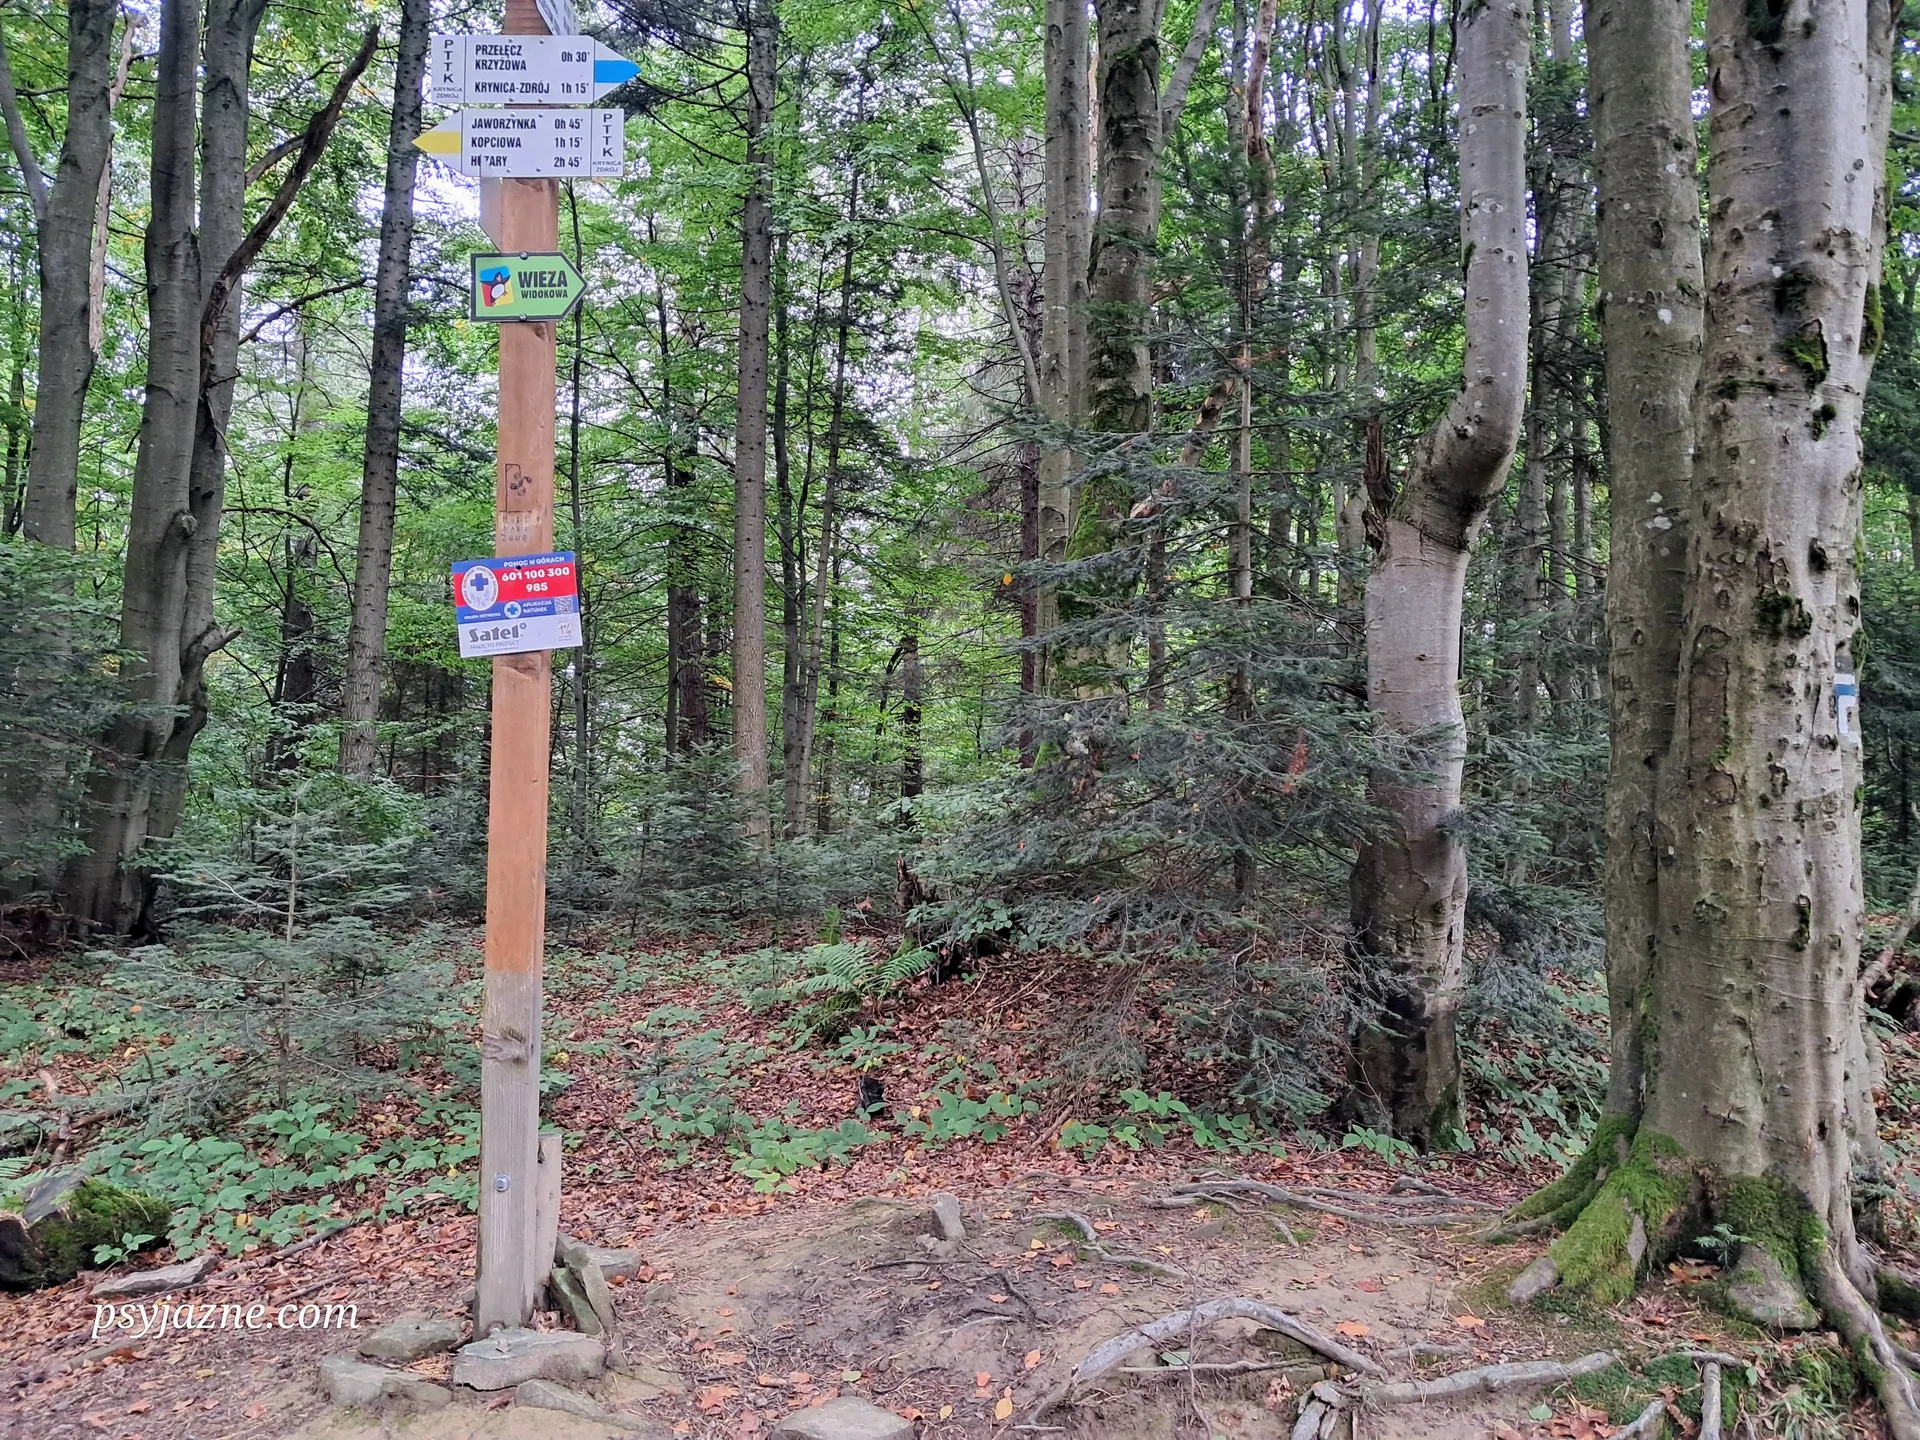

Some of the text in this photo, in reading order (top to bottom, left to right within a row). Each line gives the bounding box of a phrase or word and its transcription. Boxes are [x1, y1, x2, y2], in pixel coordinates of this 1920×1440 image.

[475, 44, 522, 58] PRZEŁĘCZ
[561, 51, 573, 63] 0h
[475, 57, 527, 71] KRZYŻOWA
[474, 80, 550, 94] KRYNICA-ZDRÓJ
[560, 82, 572, 94] 1h
[471, 118, 537, 130] JAWORZYNKA
[554, 118, 566, 130] 0h
[471, 136, 522, 148] KOPCIOWA
[554, 136, 566, 148] 1h
[553, 156, 566, 168] 2h
[521, 289, 568, 299] WIDOKOWA
[503, 556, 565, 568] POMOC W GÓRACH
[501, 566, 570, 582] 601 100 300
[525, 581, 549, 593] 985
[468, 625, 520, 643] Satel
[495, 640, 519, 648] PROTECT
